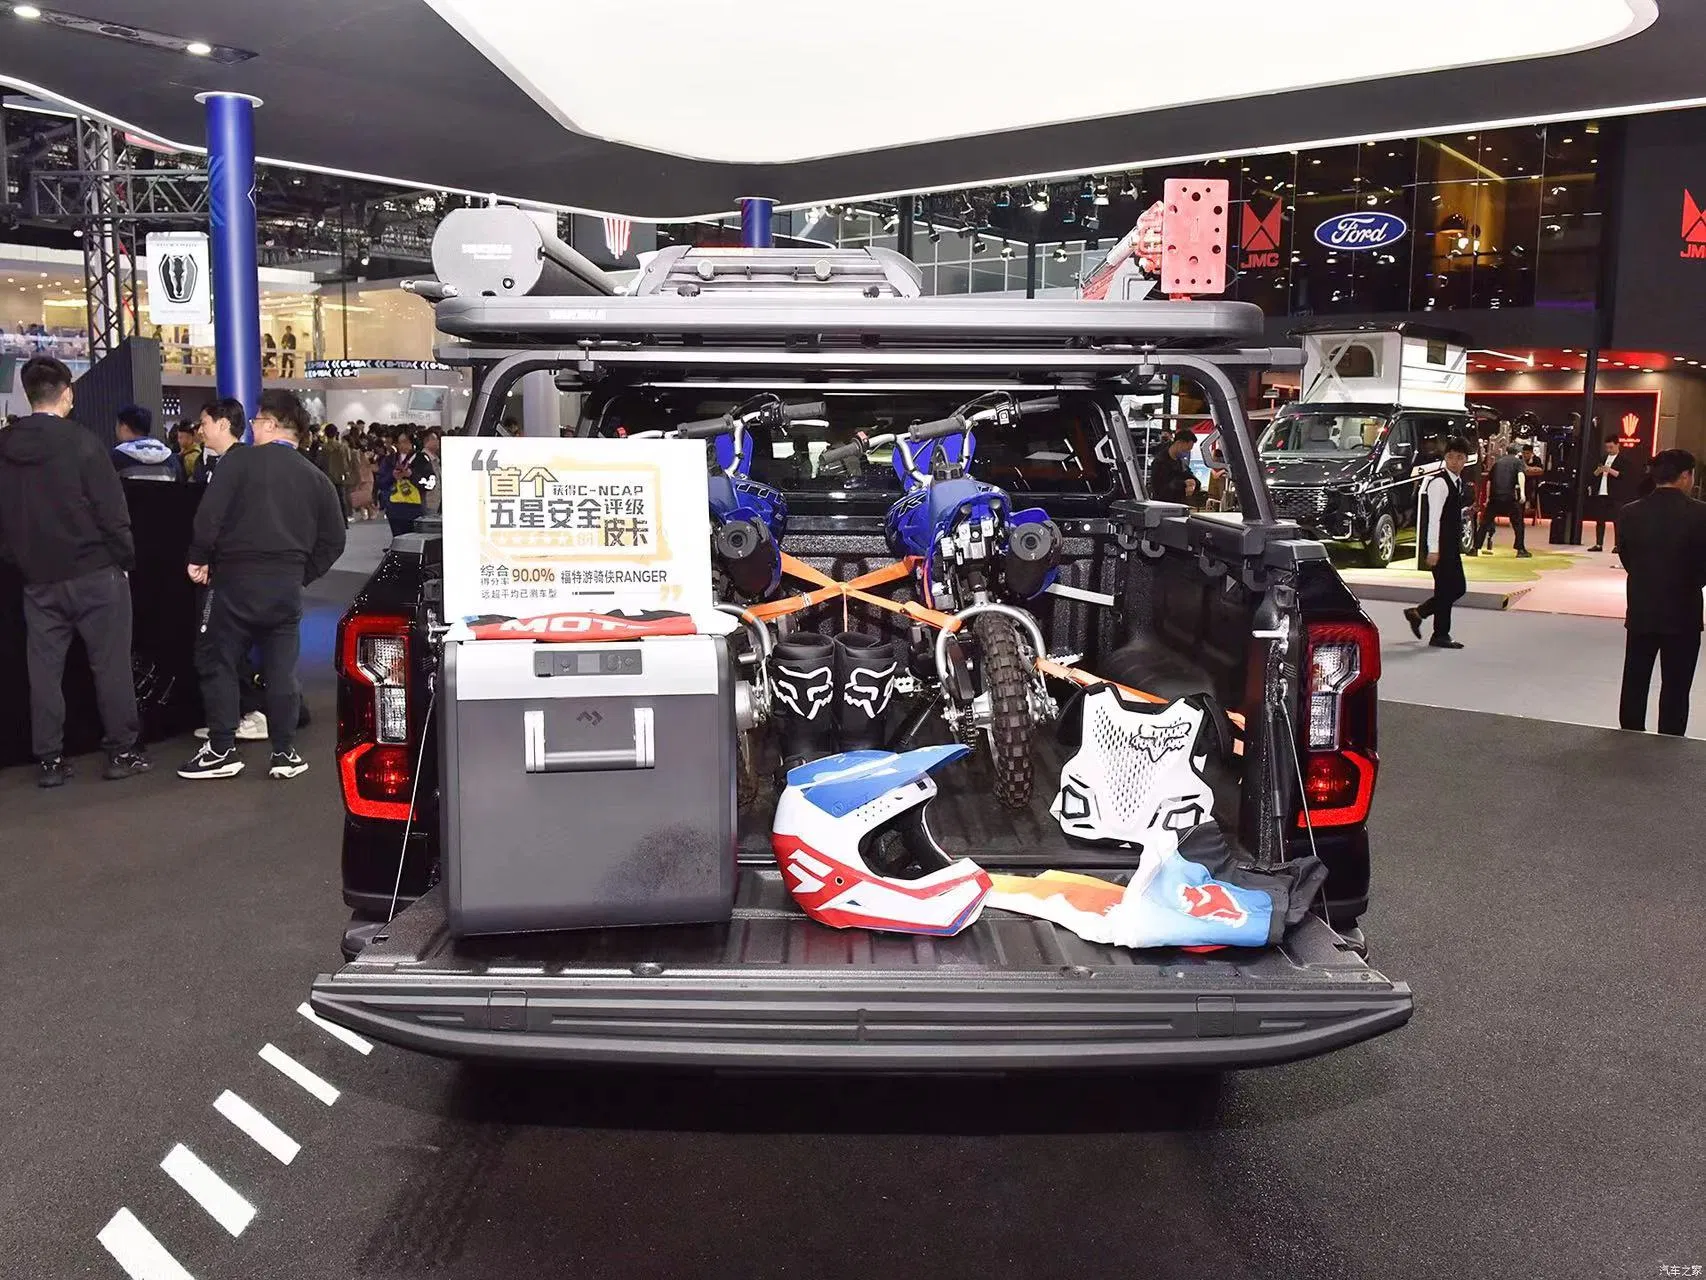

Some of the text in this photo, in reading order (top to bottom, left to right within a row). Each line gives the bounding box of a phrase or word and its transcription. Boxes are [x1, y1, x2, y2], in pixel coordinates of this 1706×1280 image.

[1331, 217, 1389, 245] Ford
[1680, 243, 1706, 259] JM
[1240, 252, 1280, 269] JMC
[488, 466, 559, 497] 首个
[604, 518, 649, 547] 皮卡
[480, 564, 510, 577] 综合
[512, 568, 555, 583] 90.0%
[480, 577, 510, 587] 得分率
